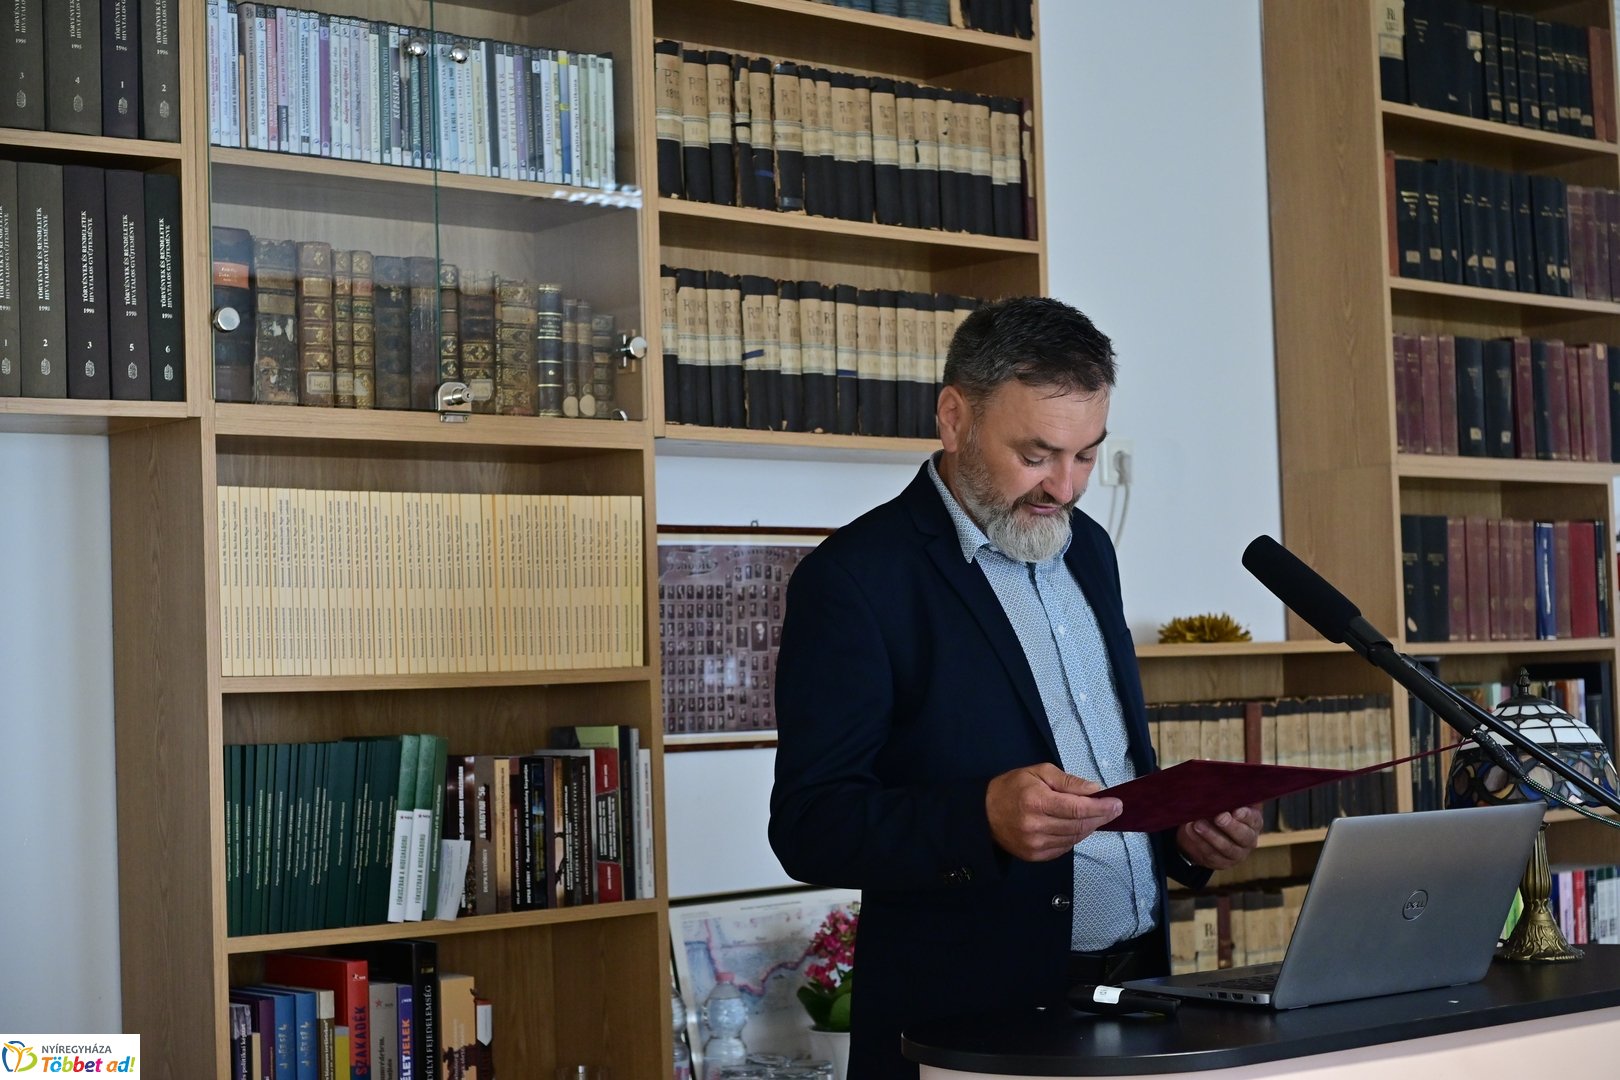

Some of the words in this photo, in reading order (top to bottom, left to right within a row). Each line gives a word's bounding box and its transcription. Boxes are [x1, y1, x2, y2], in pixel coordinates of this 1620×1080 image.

[162, 84, 166, 92] 2
[392, 70, 400, 119] KÉPESLAPOK
[497, 73, 508, 140] KÉZIRATTÁR
[260, 118, 266, 126] Az
[508, 86, 517, 151] KÉZIRATTÁR
[37, 251, 43, 259] ÉS
[82, 254, 88, 262] ÉS
[160, 260, 166, 268] ÉS
[43, 339, 48, 347] 2
[88, 341, 92, 349] 3
[166, 345, 170, 353] 6
[477, 786, 486, 799] '56
[400, 835, 408, 870] HIDEGHÁBORÚ
[418, 834, 426, 868] HIDEGHÁBORÚ
[396, 876, 405, 906] FÓKUSZBAN
[415, 875, 423, 904] FÓKUSZBAN
[424, 985, 434, 1052] FEJEDELEMSÉG
[352, 1006, 368, 1076] SZAKADÉK
